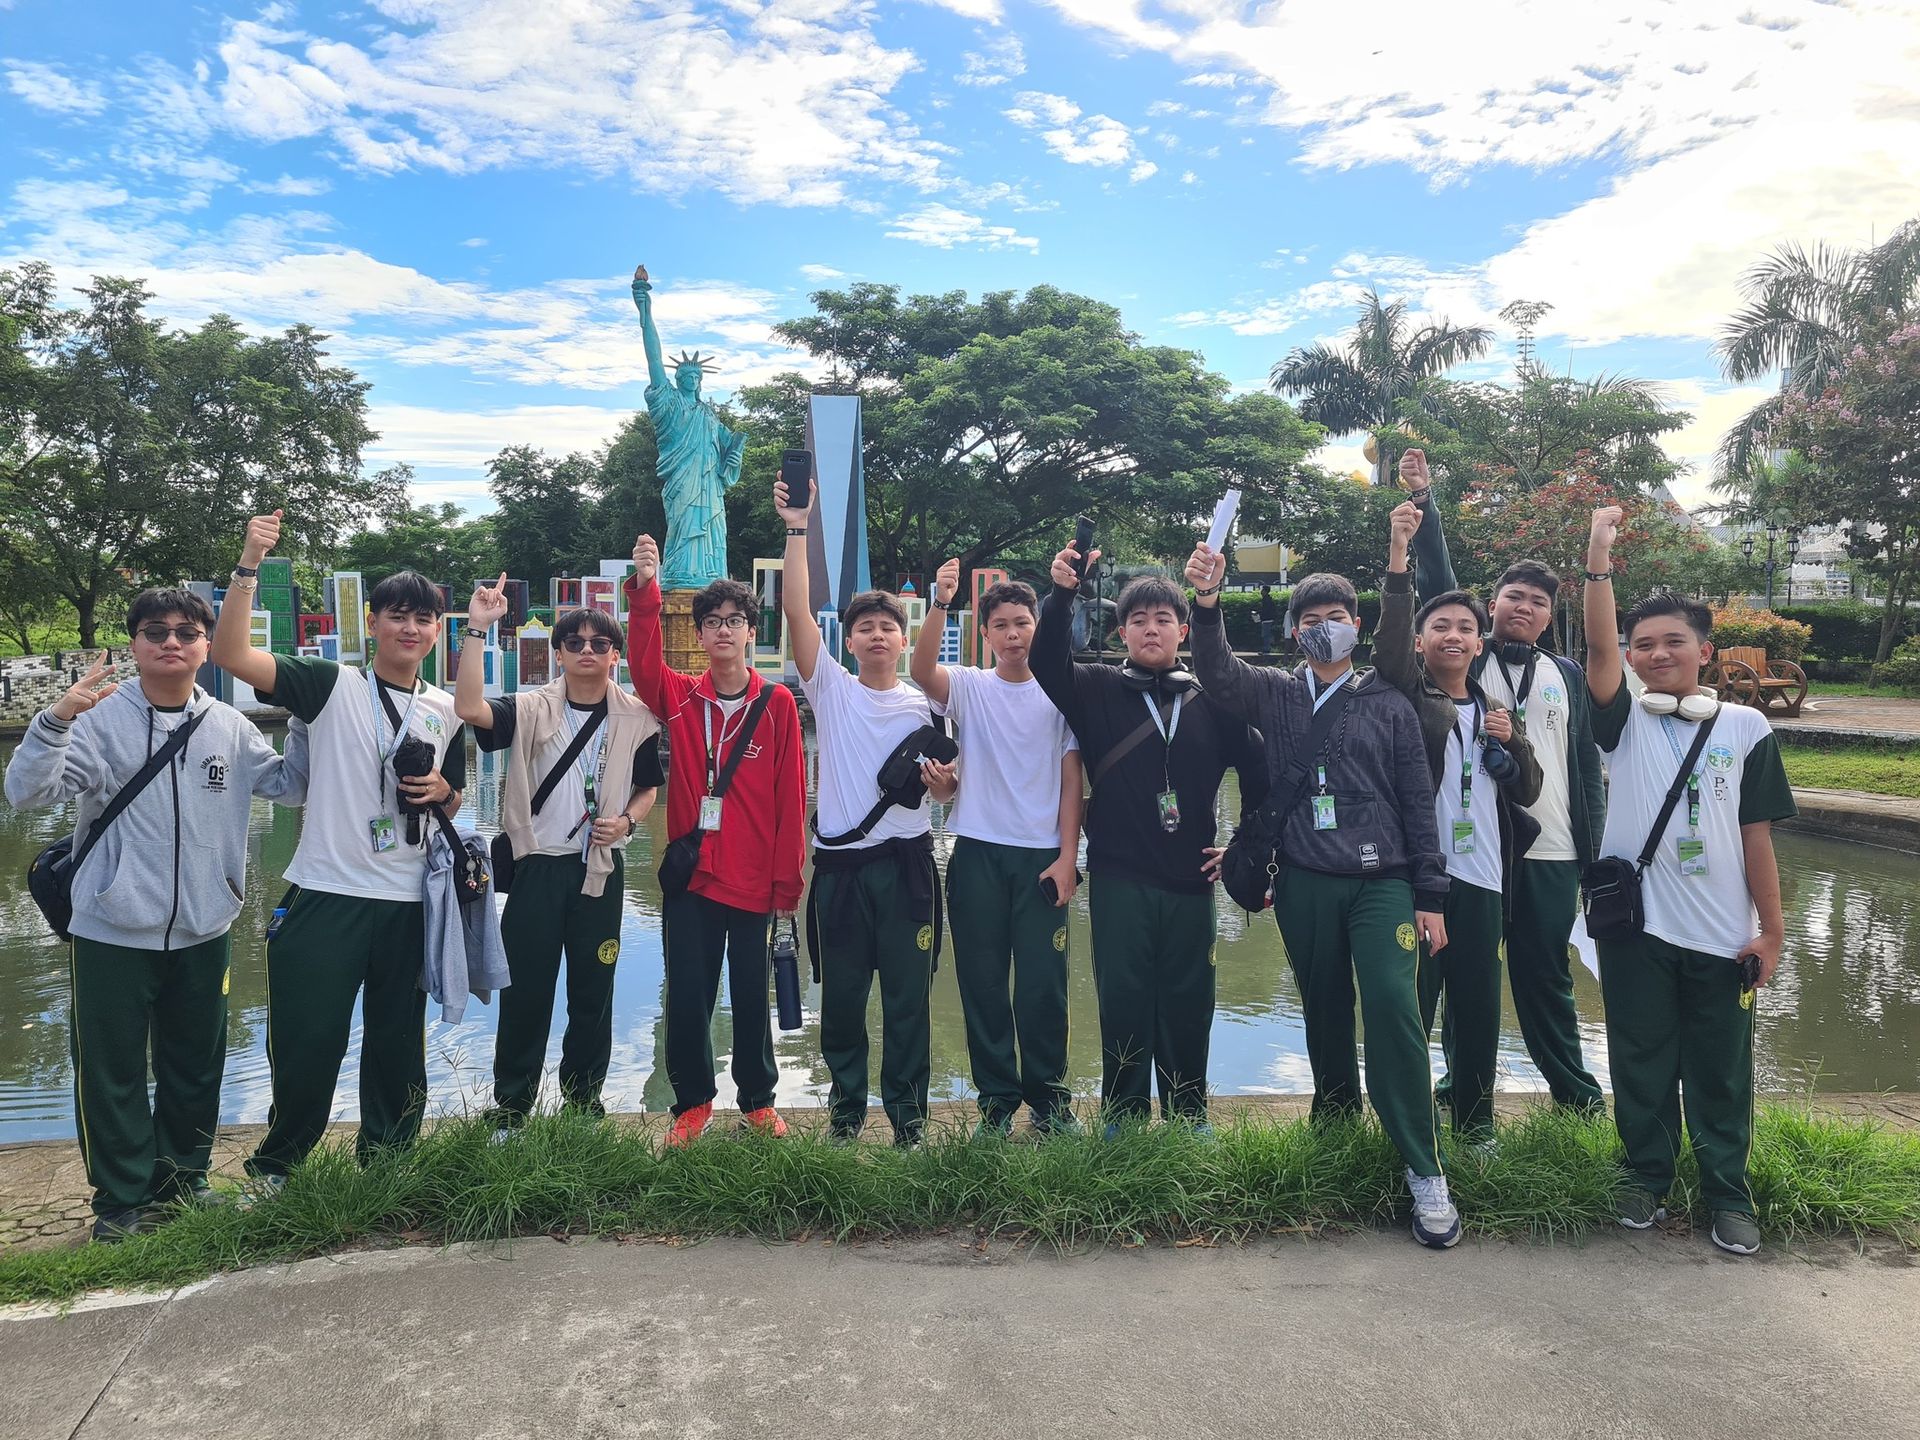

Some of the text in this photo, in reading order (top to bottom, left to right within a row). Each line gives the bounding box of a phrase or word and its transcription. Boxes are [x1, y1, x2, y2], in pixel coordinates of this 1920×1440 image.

[1547, 710, 1558, 720] P.
[209, 765, 224, 781] 09
[1714, 776, 1728, 789] P.
[1715, 789, 1726, 801] E.
